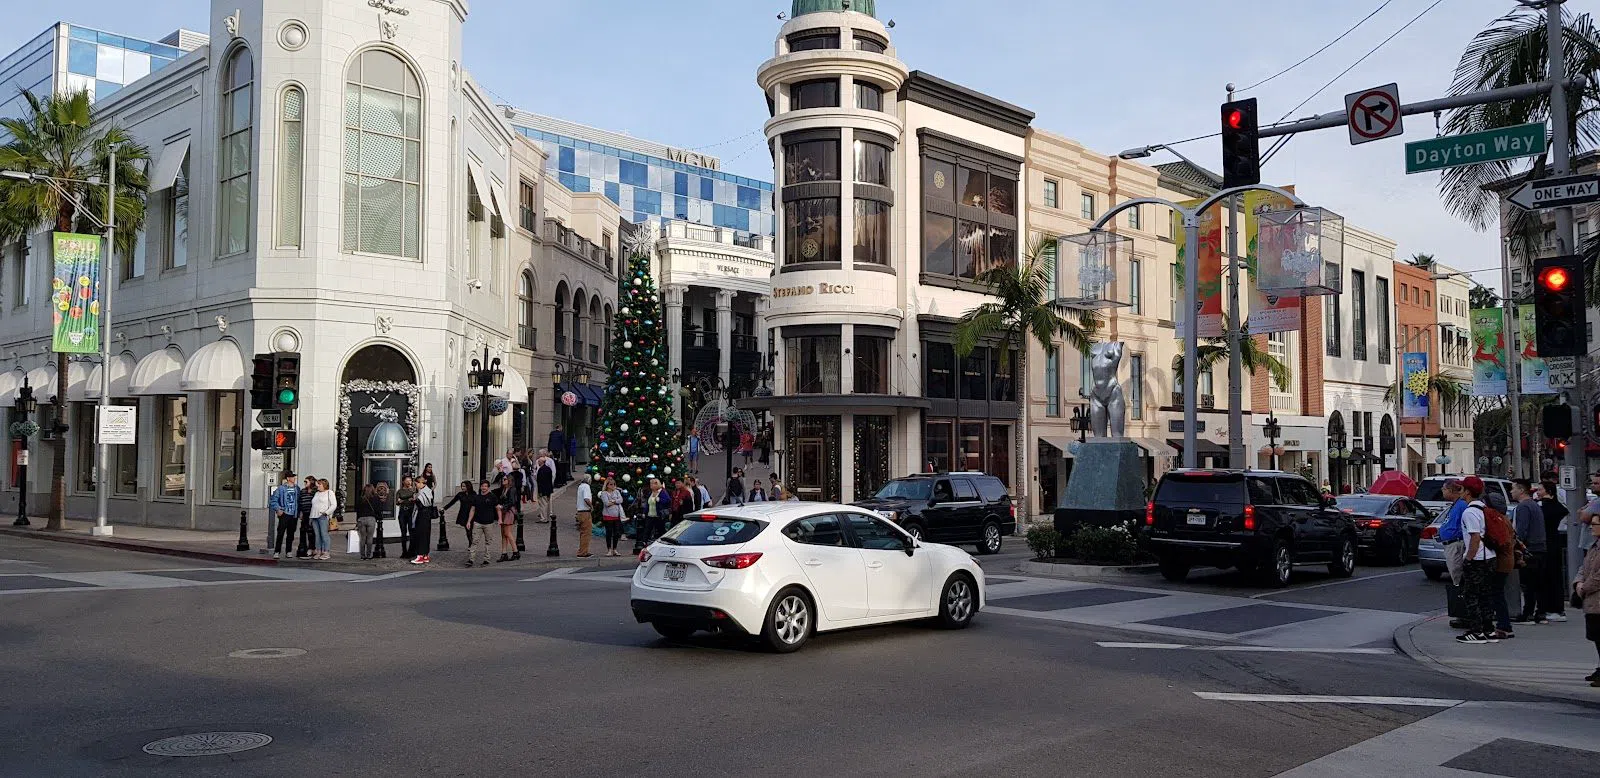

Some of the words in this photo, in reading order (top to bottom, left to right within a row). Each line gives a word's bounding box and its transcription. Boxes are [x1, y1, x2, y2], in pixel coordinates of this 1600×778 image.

[666, 147, 715, 170] MGM
[1415, 142, 1486, 165] Dayton
[1493, 135, 1535, 152] Way
[1534, 187, 1562, 200] ONE
[1566, 182, 1594, 197] WAY
[773, 285, 815, 299] STEFANO
[818, 282, 856, 295] RICCI
[1549, 362, 1574, 371] CROSSING
[1550, 374, 1560, 385] OK
